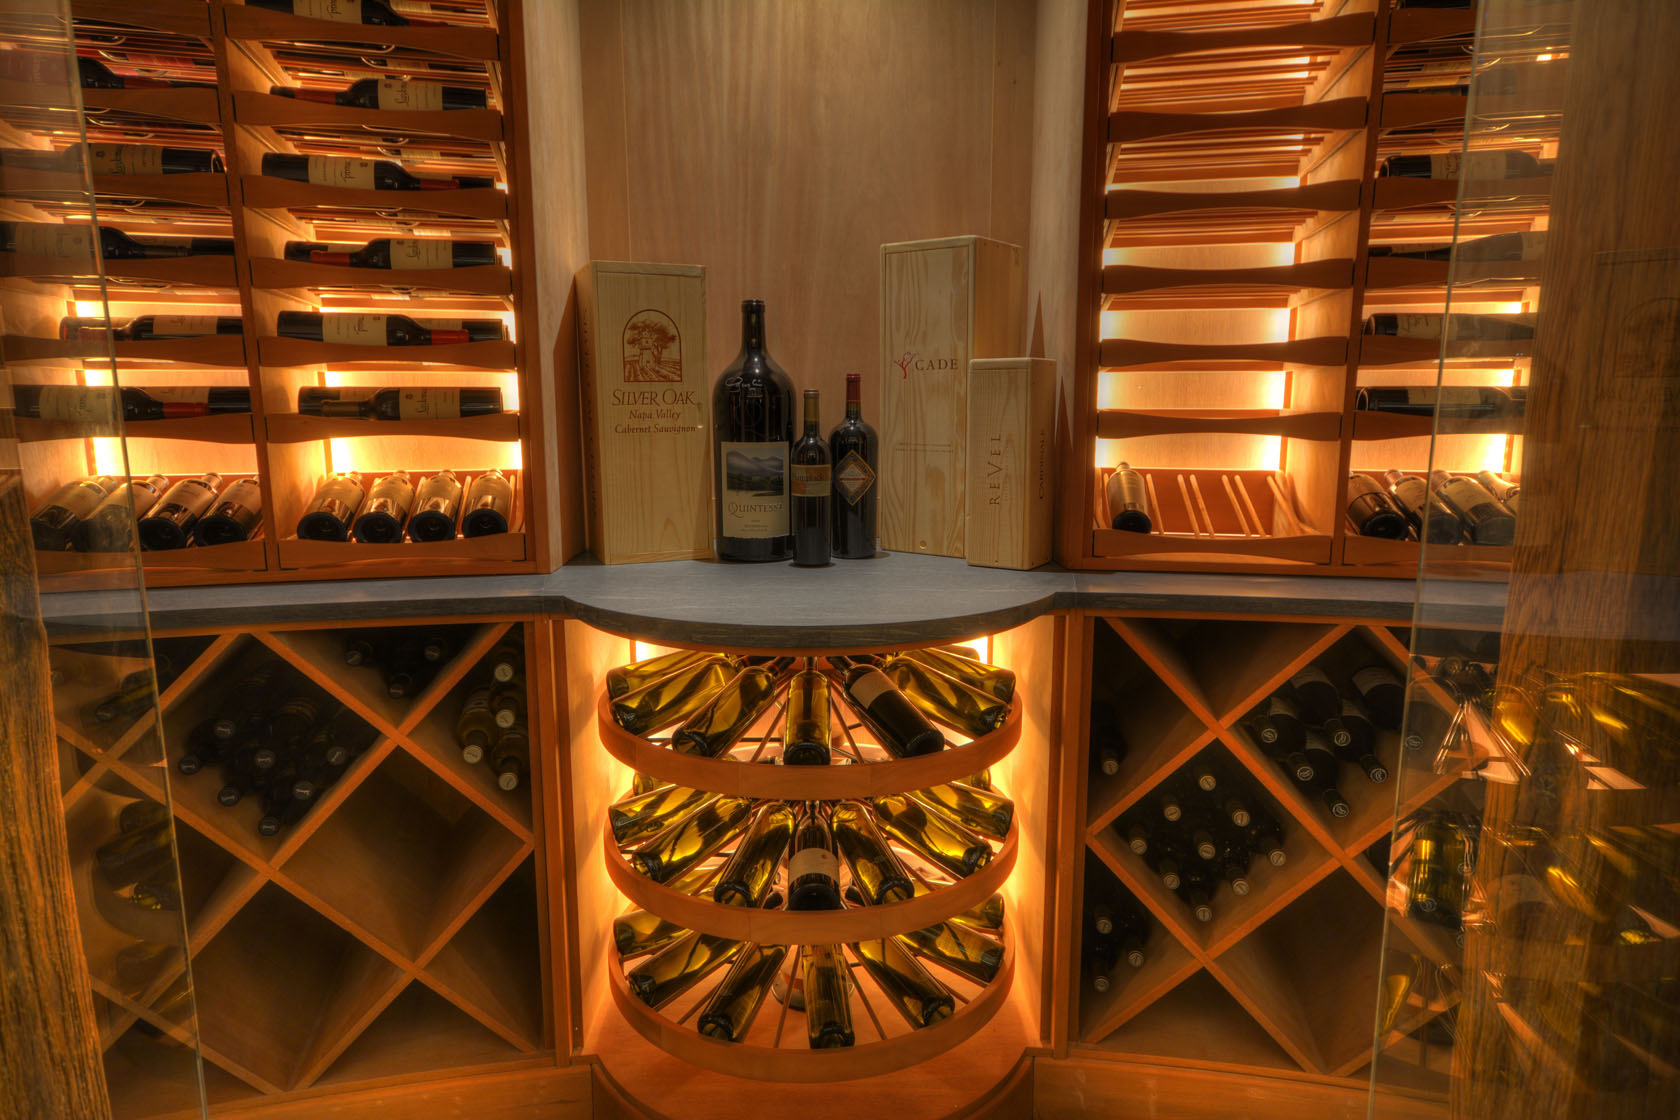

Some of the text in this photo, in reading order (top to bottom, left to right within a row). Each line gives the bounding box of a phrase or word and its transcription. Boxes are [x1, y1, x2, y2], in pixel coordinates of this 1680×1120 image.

[914, 358, 959, 371] CADE
[612, 388, 696, 406] SILVER OAK
[629, 408, 681, 421] Napa Valley
[614, 423, 696, 435] Cabernet Sauvignon
[987, 433, 1002, 505] REVEL
